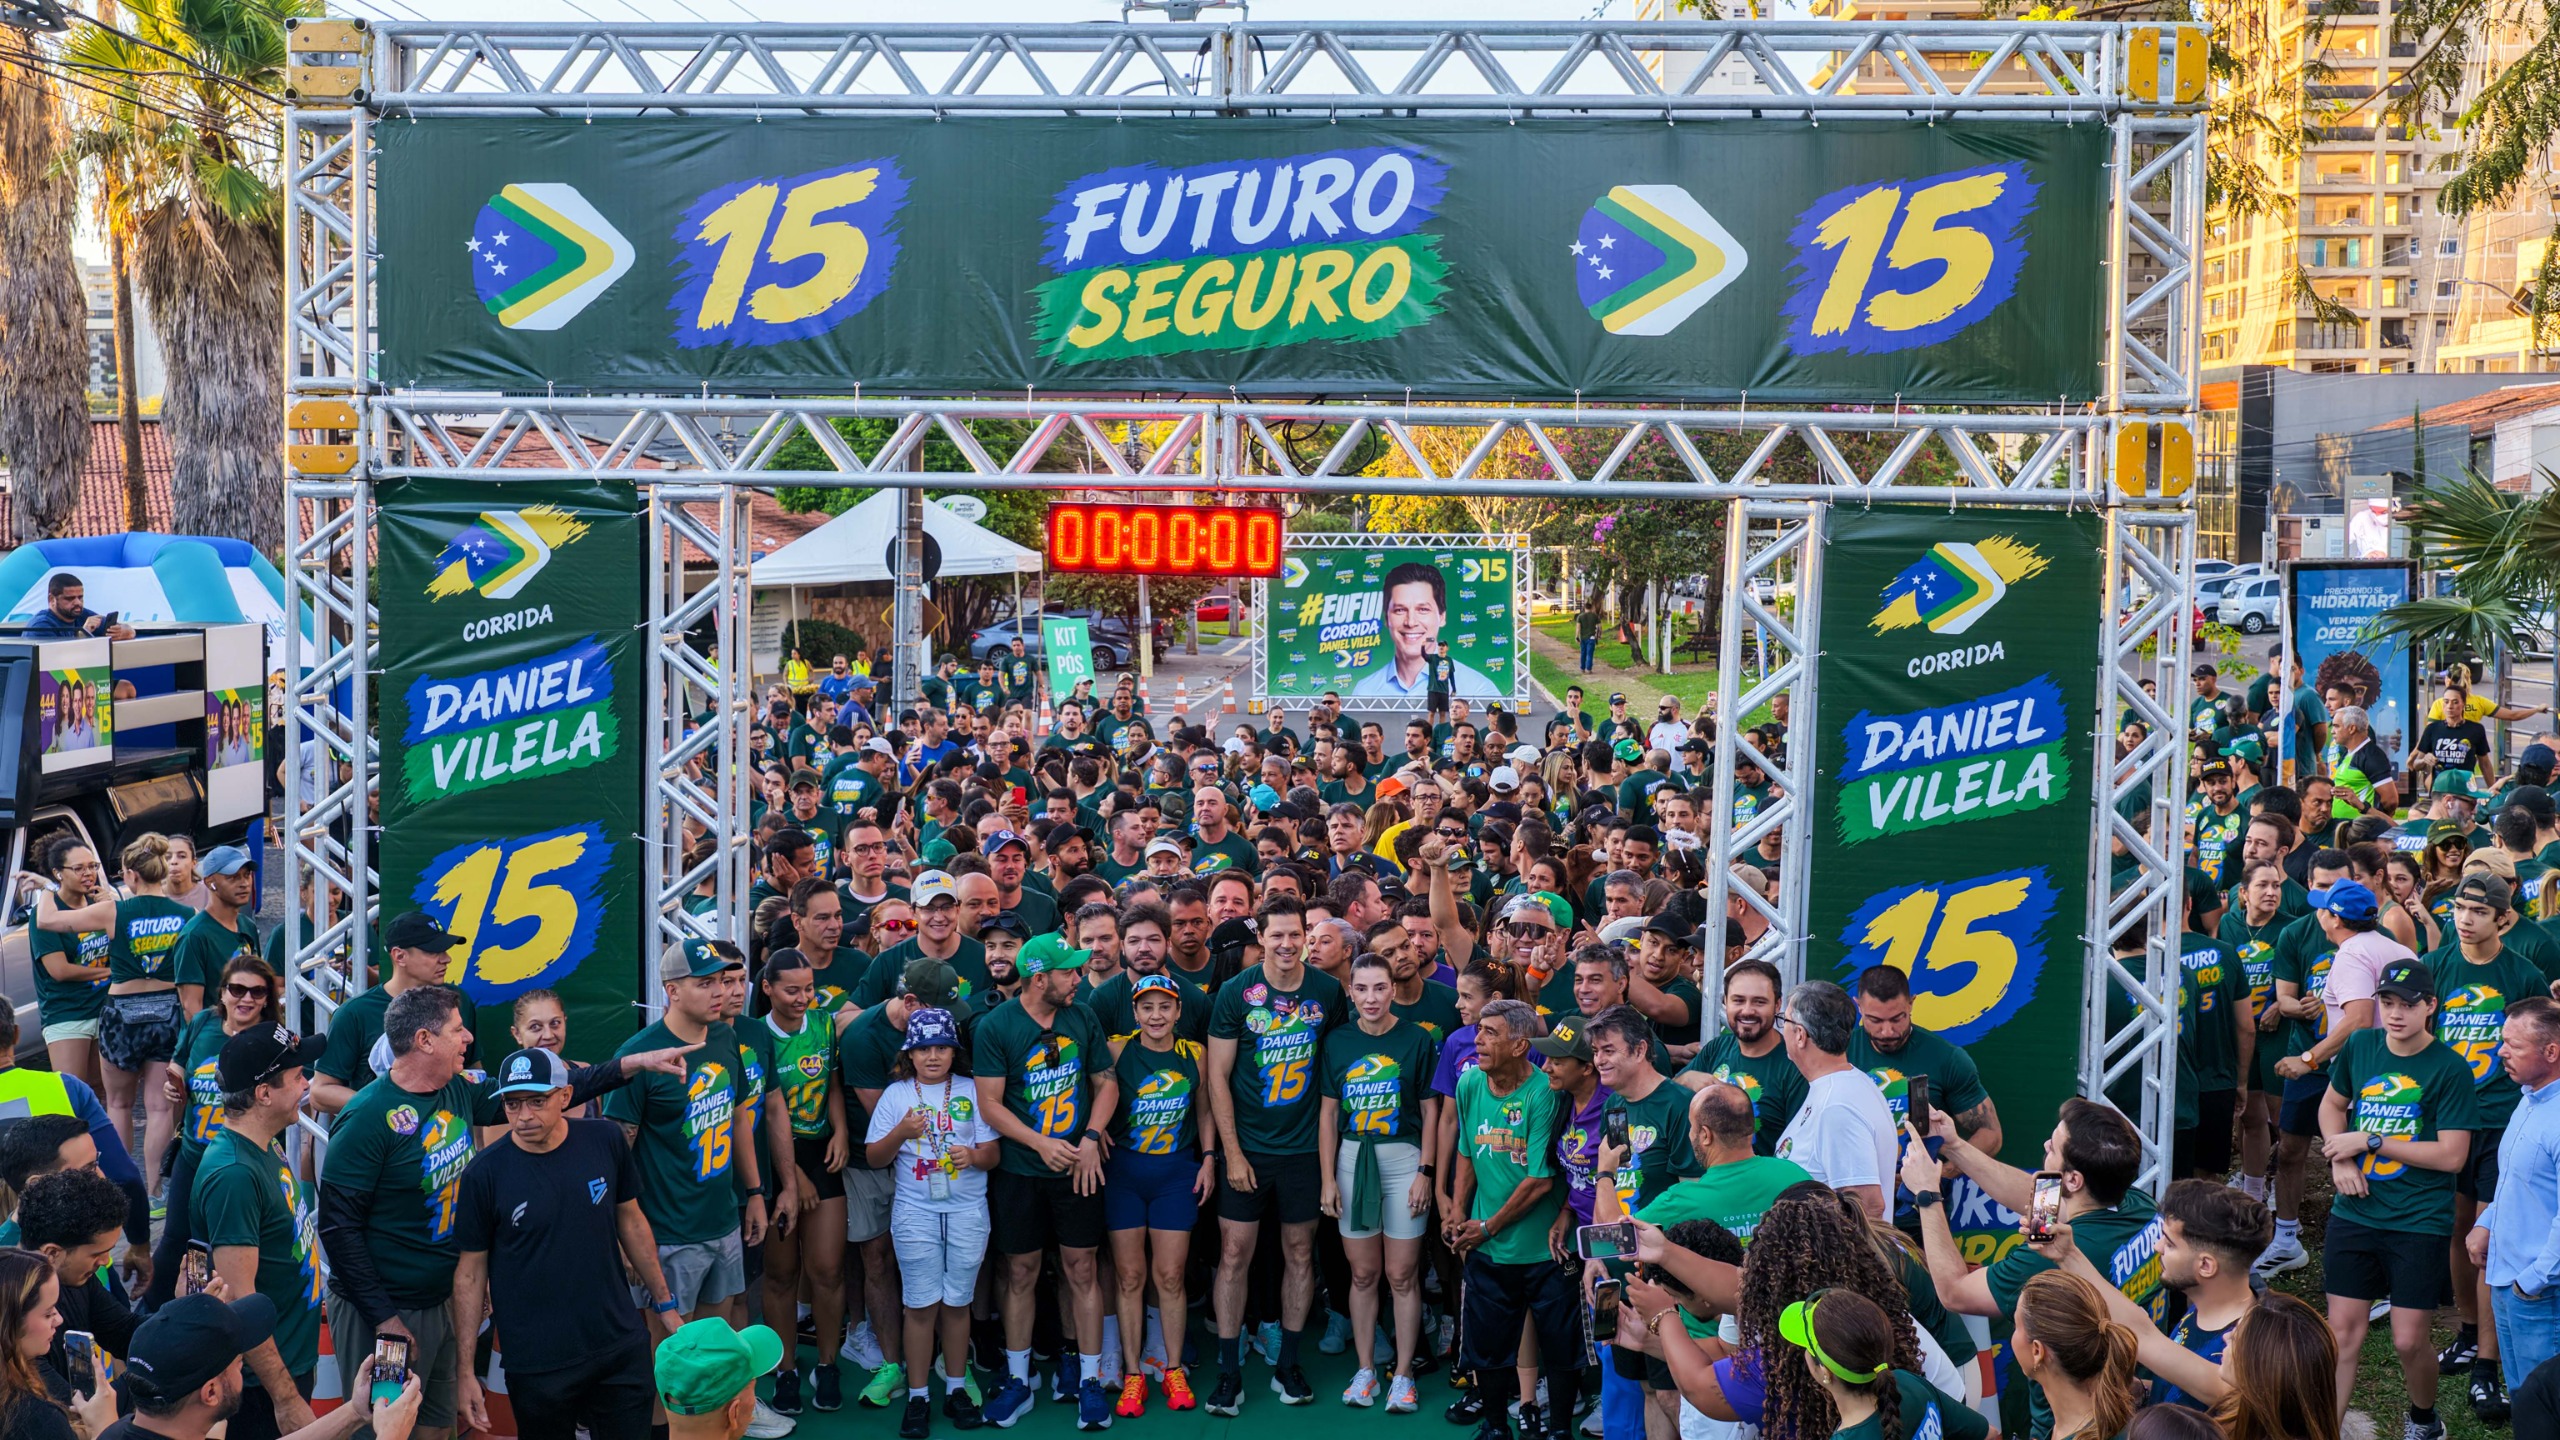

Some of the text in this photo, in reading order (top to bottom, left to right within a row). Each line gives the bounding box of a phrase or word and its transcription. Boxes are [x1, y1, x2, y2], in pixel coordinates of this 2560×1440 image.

[1064, 153, 1415, 265] FUTURO
[694, 167, 881, 330] 15
[1810, 171, 2008, 337] 15
[1067, 246, 1412, 349] SEGURO
[1056, 510, 1275, 568] 00:00:00
[1480, 558, 1507, 582] 15
[2310, 593, 2398, 609] HIDRATAR?
[2324, 586, 2384, 595] PRECISANDO SE
[463, 604, 554, 643] CORRIDA
[1320, 620, 1379, 642] CORRIDA
[2328, 616, 2368, 625] VEM PRO
[1055, 625, 1076, 648] KIT
[1319, 635, 1381, 654] DANIEL VILELA
[1057, 651, 1085, 677] PÓS
[1352, 650, 1371, 667] 15
[1907, 641, 2004, 678] CORRIDA
[40, 692, 56, 709] 444
[421, 658, 594, 735] DANIEL
[98, 705, 112, 734] 15
[252, 722, 263, 749] 15
[1859, 697, 2046, 774] DANIEL
[2435, 738, 2457, 750] 1%
[430, 711, 604, 790] VILELA
[2215, 761, 2225, 769] 15
[1869, 751, 2055, 832] VILELA
[2396, 836, 2428, 849] FUTUR
[1308, 849, 1319, 859] 15
[2200, 859, 2222, 880] 15
[430, 832, 589, 986] 15
[131, 916, 182, 937] FUTURO
[81, 934, 109, 954] DANIE
[134, 932, 178, 953] SEGURO
[81, 945, 109, 964] VILEL
[1858, 876, 2031, 1033] 15
[2181, 950, 2218, 969] TURO
[2244, 963, 2269, 973] NIEL
[2248, 974, 2272, 985] ELA
[2443, 1013, 2492, 1026] DANIEL
[1262, 1031, 1311, 1050] DANIEL
[1266, 1028, 1287, 1036] CORRIDA
[1558, 1024, 1575, 1041] 15
[2443, 1025, 2502, 1042] VILELA
[800, 1059, 822, 1069] 444
[1262, 1042, 1313, 1065] VILELA
[1029, 1062, 1076, 1085] DANIEL
[1032, 1063, 1047, 1071] CORRI
[192, 1079, 220, 1092] DAN
[1031, 1073, 1078, 1101] VILELA
[1267, 1058, 1310, 1103] 15
[1347, 1082, 1394, 1097] DANIEL
[194, 1093, 222, 1106] VILE
[689, 1091, 731, 1118] DANIEL
[788, 1079, 826, 1122] 15
[959, 1101, 970, 1111] 15
[1136, 1097, 1185, 1113] DANIEL
[1349, 1094, 1397, 1111] VILELA
[691, 1103, 733, 1135] VILELA
[1038, 1087, 1076, 1137] 15
[1136, 1108, 1186, 1126] VILELA
[2359, 1103, 2413, 1118] DANIEL
[1354, 1108, 1396, 1136] 15
[2358, 1117, 2418, 1135] VILELA
[698, 1120, 732, 1177] 15
[1137, 1123, 1177, 1155] 15
[429, 1135, 468, 1170] DANIEL
[432, 1148, 474, 1190] VILELA
[1615, 1170, 1637, 1188] ELA
[2114, 1216, 2165, 1286] FUTUR
[2121, 1252, 2163, 1301] SEGUR
